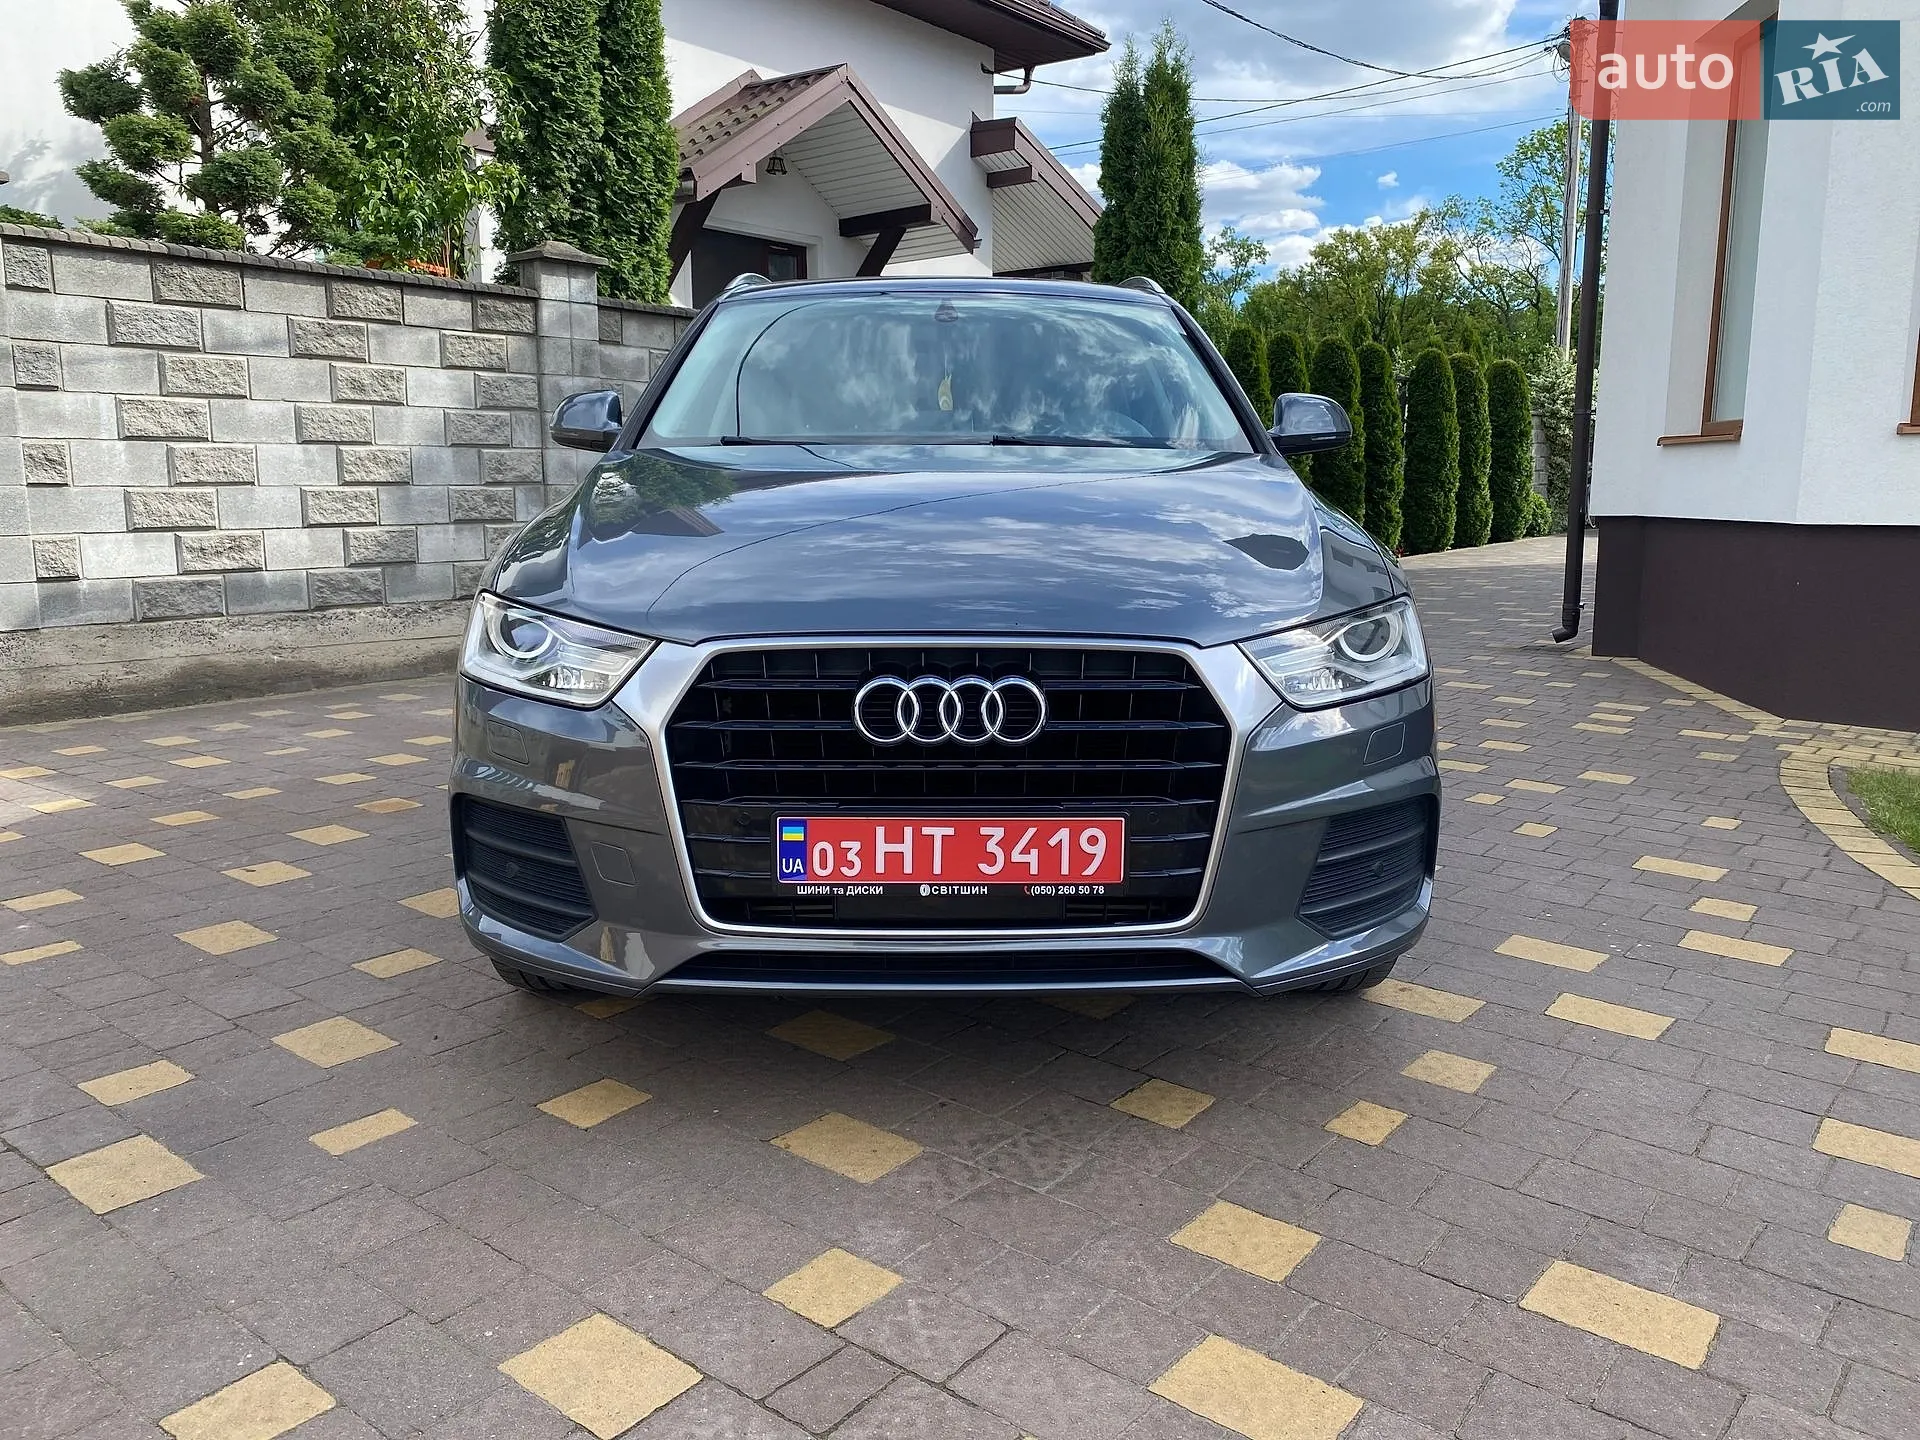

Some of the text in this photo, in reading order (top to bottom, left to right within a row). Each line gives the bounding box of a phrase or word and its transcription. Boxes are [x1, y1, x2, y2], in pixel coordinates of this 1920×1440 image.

[812, 826, 1108, 877] 03 HT 3419
[782, 858, 804, 873] UA
[797, 886, 830, 895] ШИНИ
[846, 886, 883, 896] ДИСКИ
[1031, 885, 1105, 896] (050) 260 50 78
